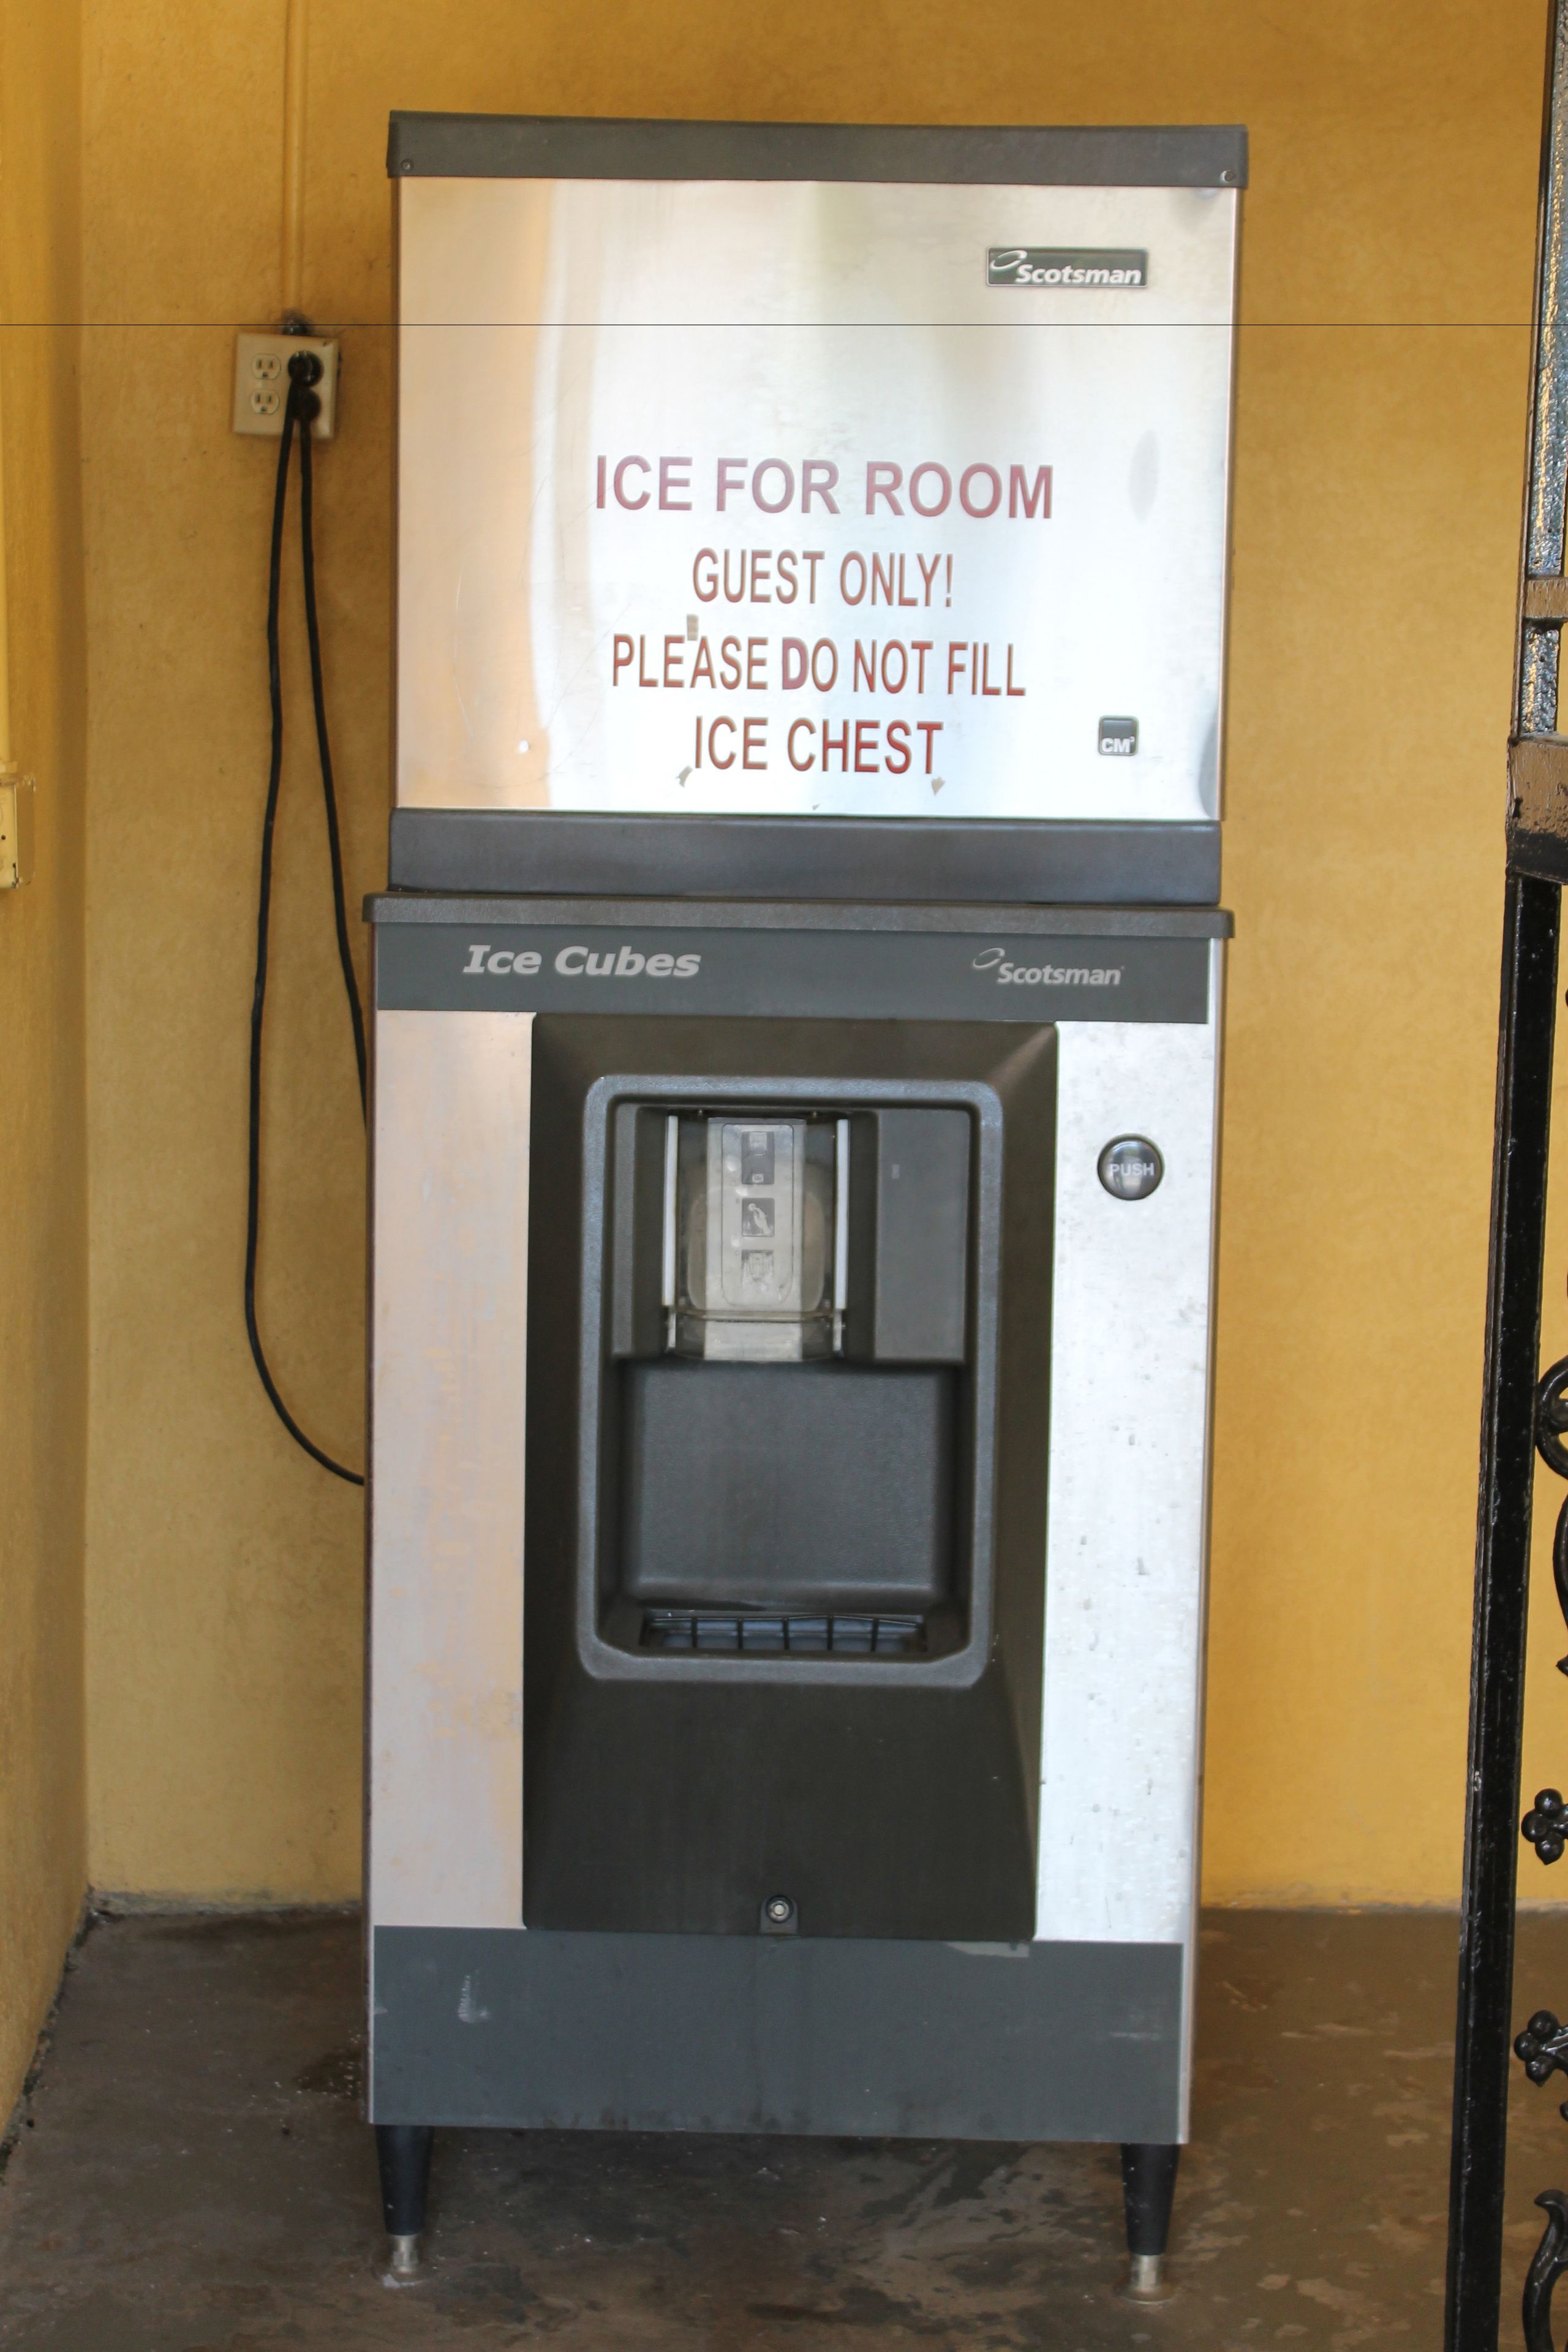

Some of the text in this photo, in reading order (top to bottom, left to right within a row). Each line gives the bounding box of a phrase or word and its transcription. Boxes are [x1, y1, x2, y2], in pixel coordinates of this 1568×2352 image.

[1016, 264, 1142, 284] Scotsman
[596, 455, 1054, 519] ICE FOR ROOM
[693, 548, 954, 607] GUEST ONLY!
[612, 633, 1026, 696] PLEASE DO NOT FILL
[695, 715, 943, 774] ICE CHEST
[463, 944, 701, 977] Ice Cubes
[997, 962, 1121, 985] Scotsman
[1109, 1163, 1155, 1177] PUSH
